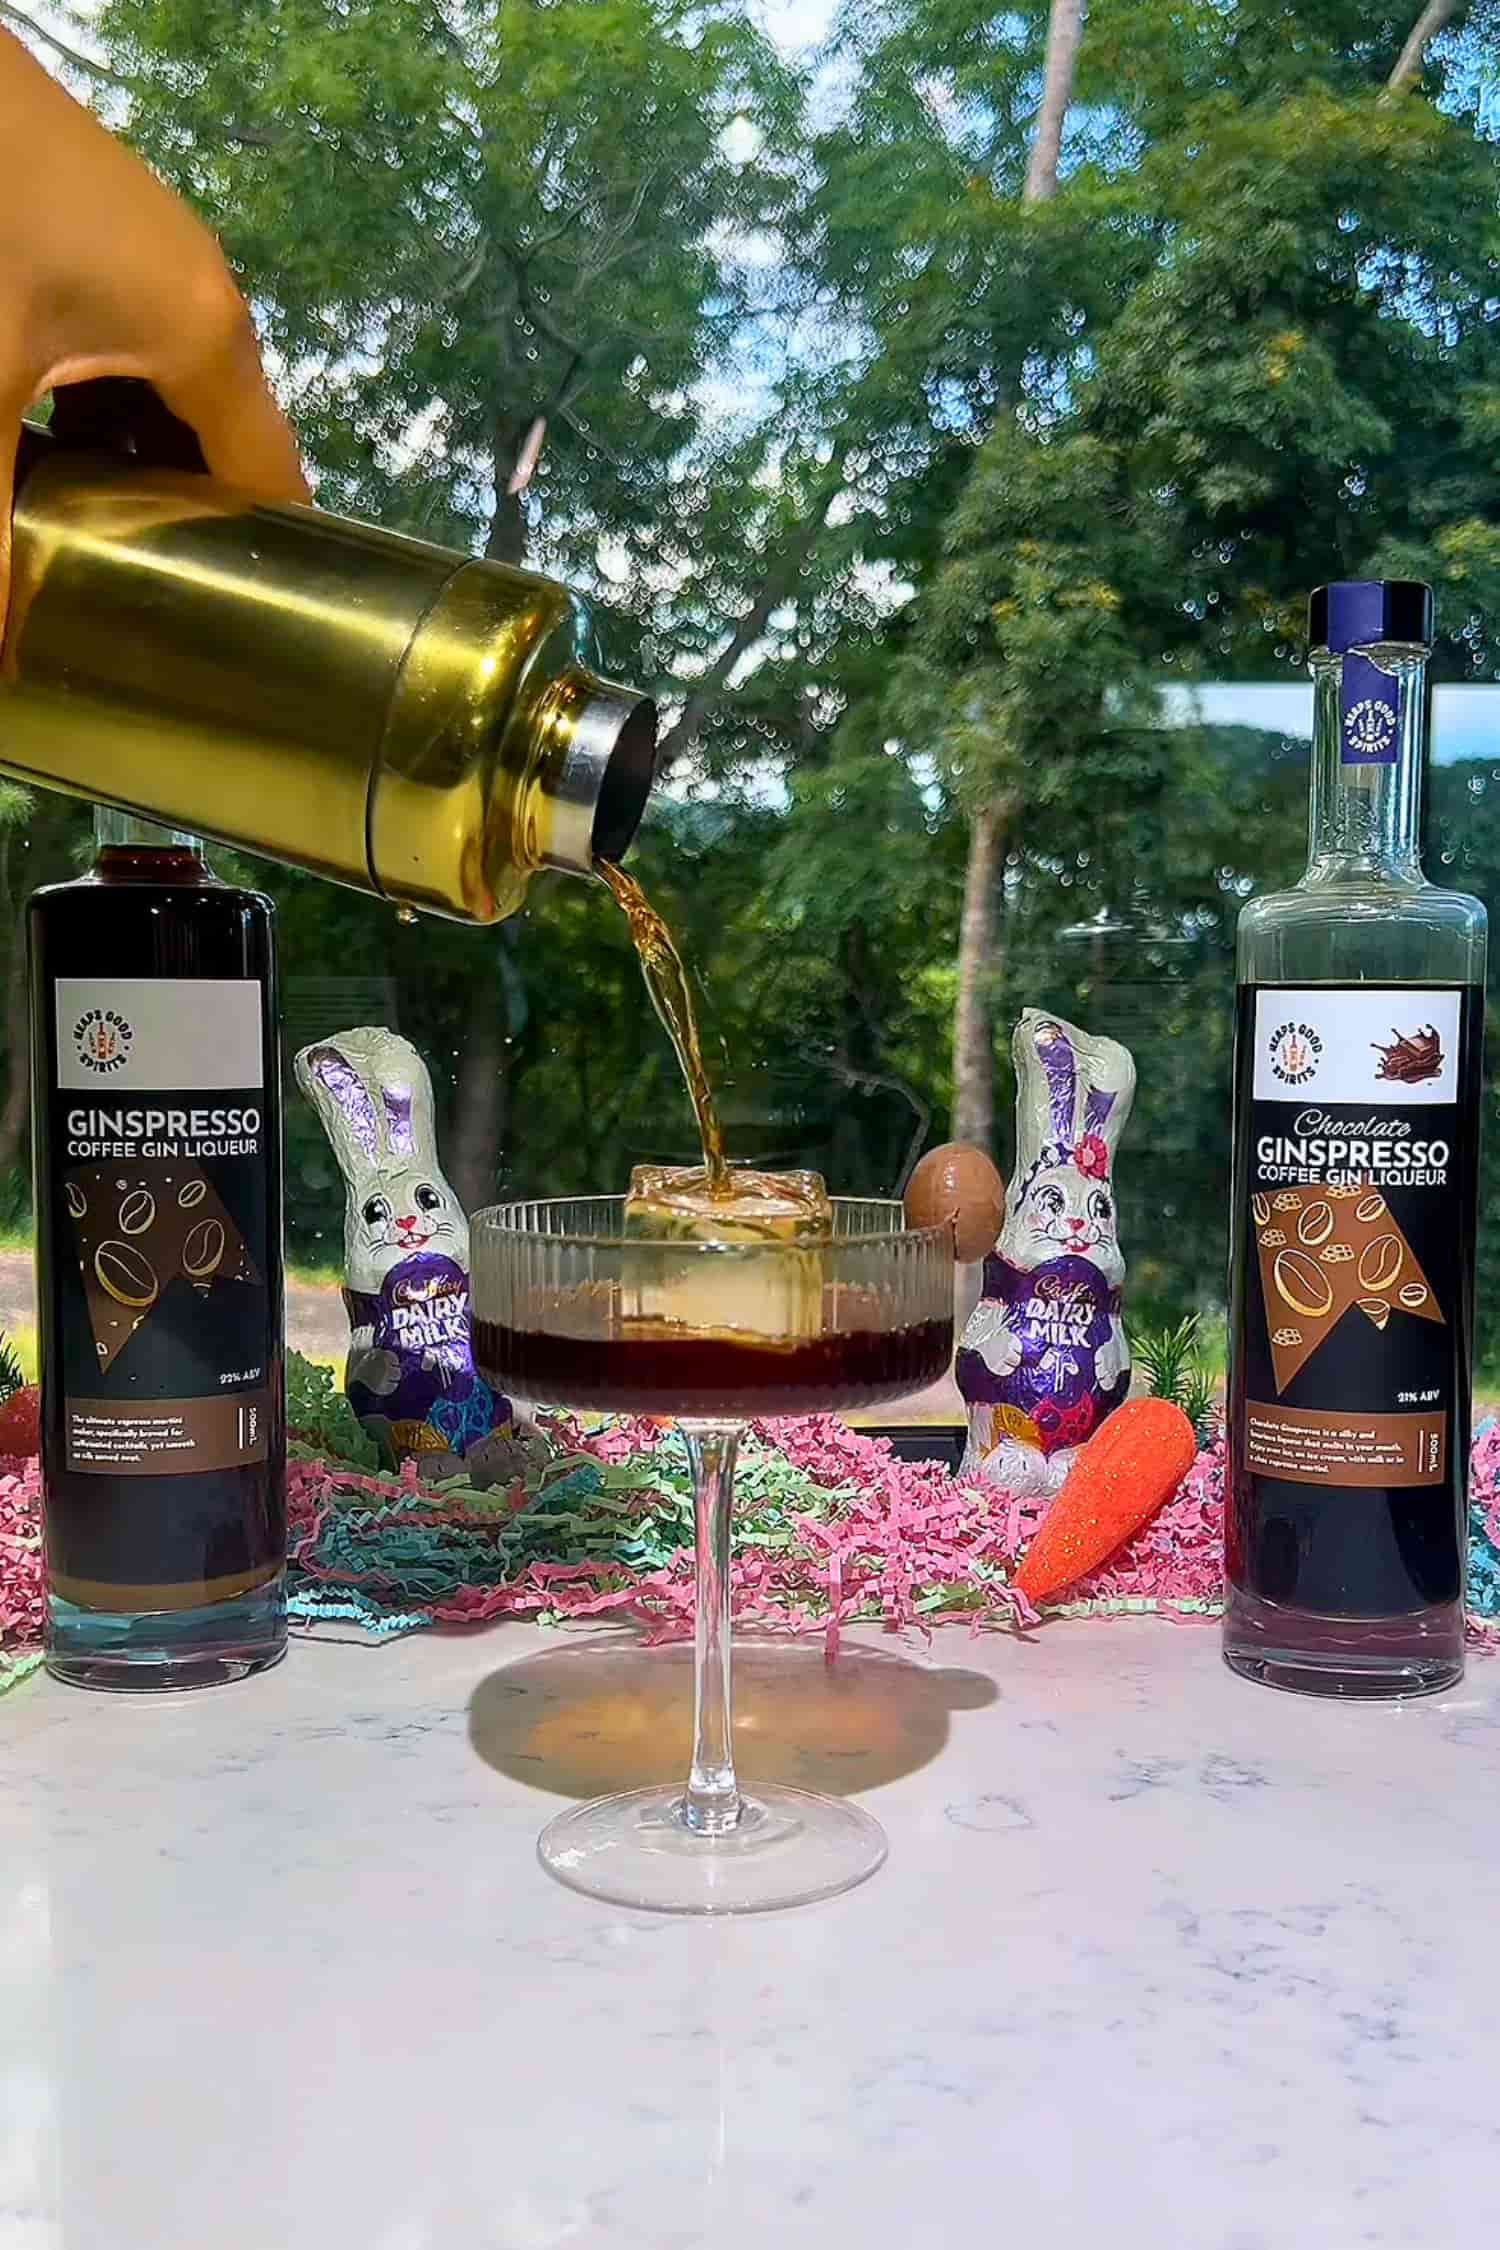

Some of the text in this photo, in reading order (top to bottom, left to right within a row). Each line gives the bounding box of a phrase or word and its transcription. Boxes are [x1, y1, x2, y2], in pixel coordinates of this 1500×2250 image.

[1344, 700, 1396, 726] HEAPS GOOD
[1348, 735, 1391, 752] SPIRITS
[105, 1011, 132, 1039] GOOD
[1269, 1022, 1322, 1053] HEAPS GOOD
[80, 1053, 126, 1072] SPIRITS
[1272, 1065, 1316, 1085] SPIRITS
[67, 1108, 260, 1137] GINSPRESSO
[1293, 1108, 1412, 1137] Chocolate
[67, 1139, 257, 1157] COFFEE GIN LIQUEUR
[1257, 1136, 1449, 1168] GINSPRESSO
[1257, 1164, 1447, 1185] COFFEE GIN LIQUEUR
[391, 1292, 468, 1330] DAIRY
[1025, 1297, 1096, 1325] DAIRY
[400, 1316, 470, 1348] MILK
[1030, 1319, 1092, 1348] MILK
[1420, 1389, 1440, 1401] ABV
